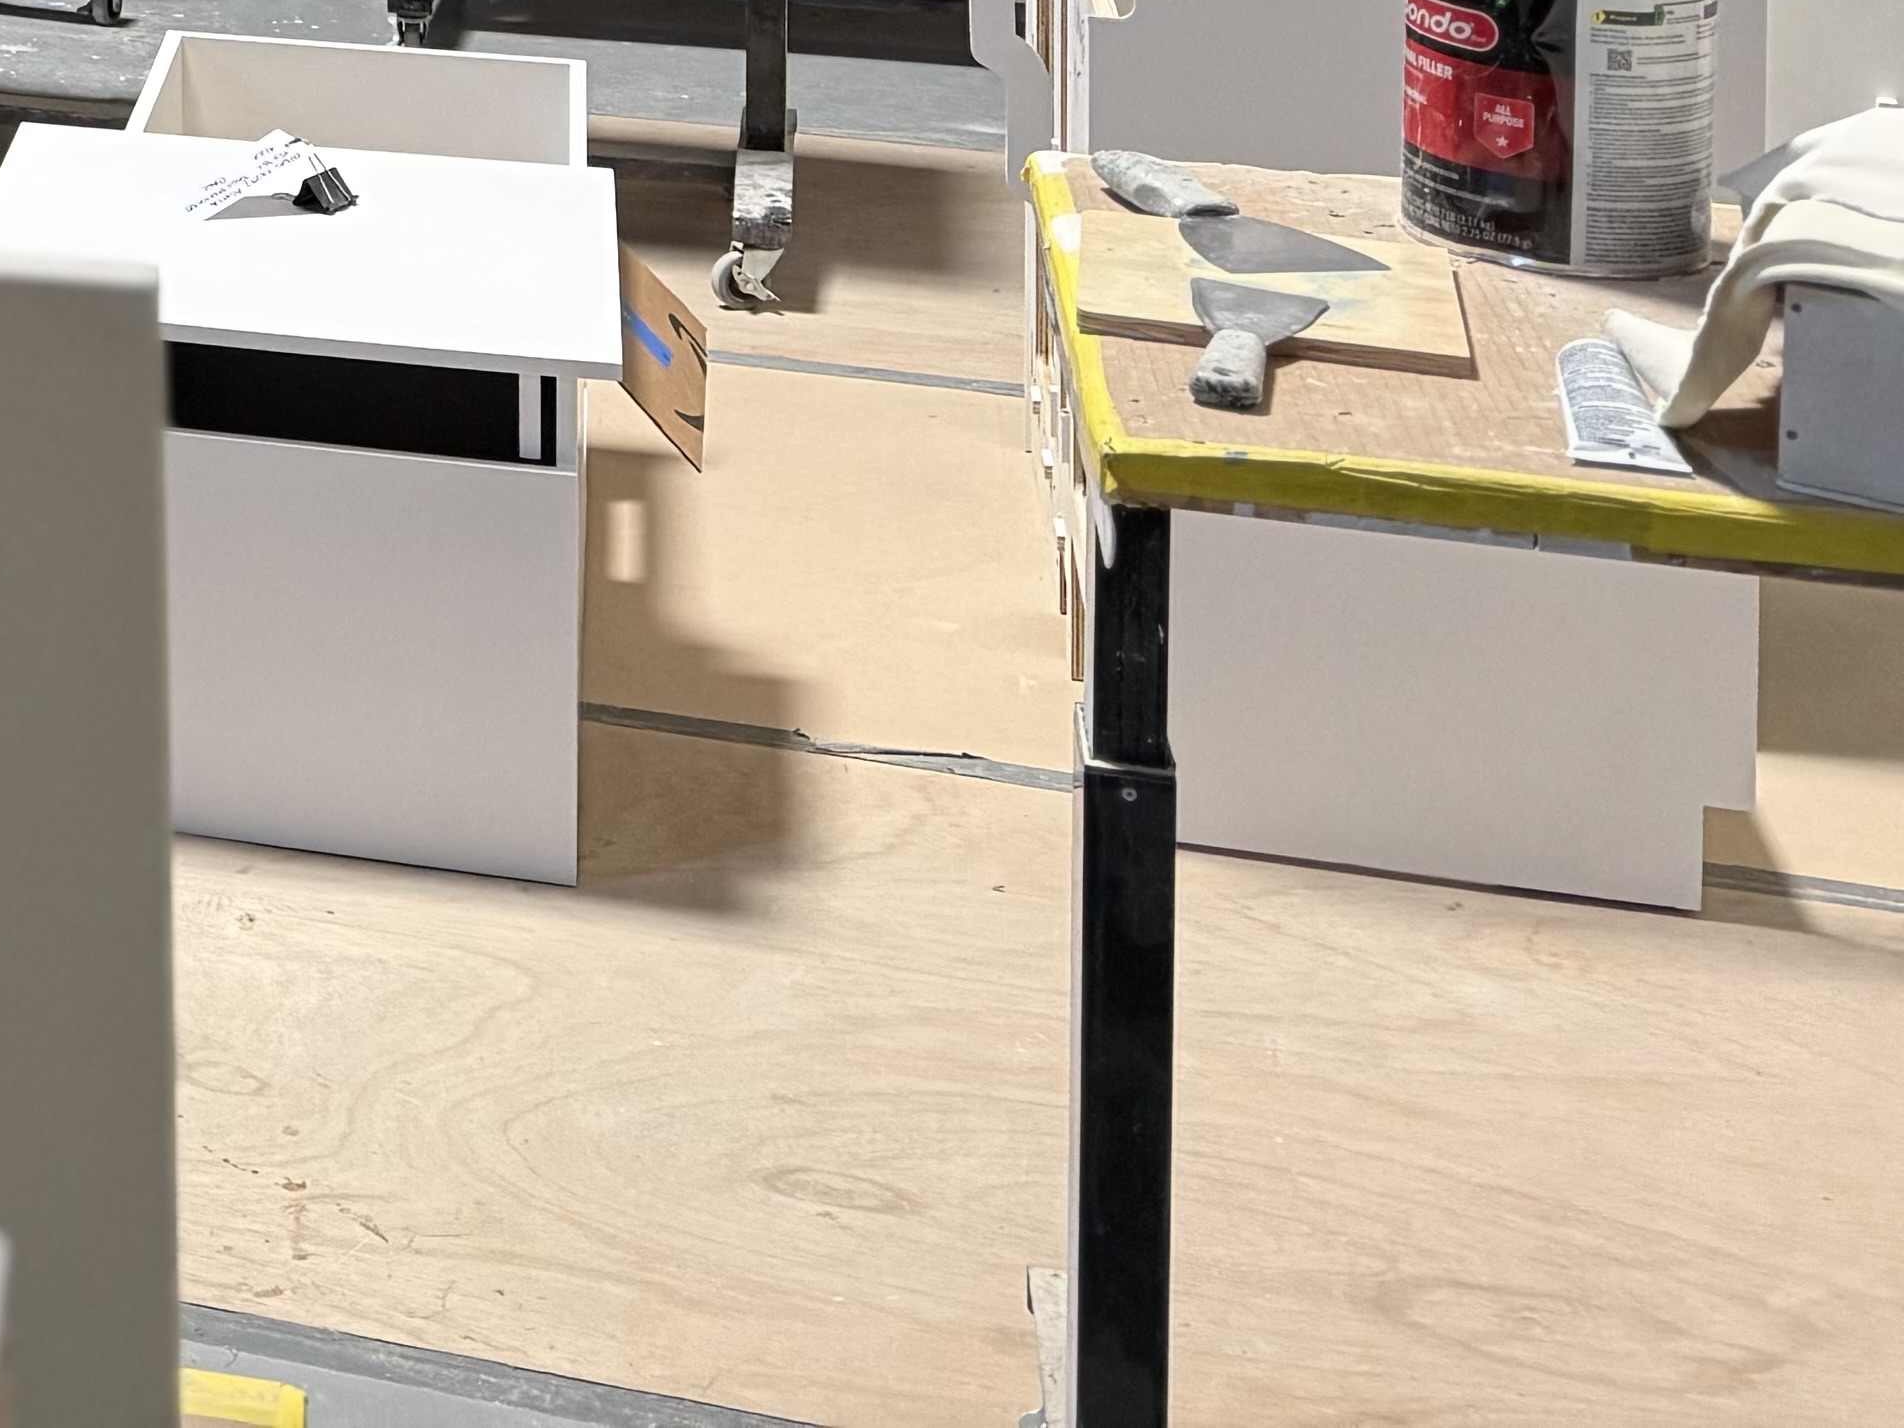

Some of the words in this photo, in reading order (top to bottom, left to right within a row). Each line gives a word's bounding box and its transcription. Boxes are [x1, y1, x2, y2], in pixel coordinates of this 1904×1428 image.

[1406, 1, 1472, 40] ondo
[1418, 56, 1453, 80] FILLER
[1483, 111, 1525, 129] PURPOSE
[1495, 104, 1511, 116] ALL
